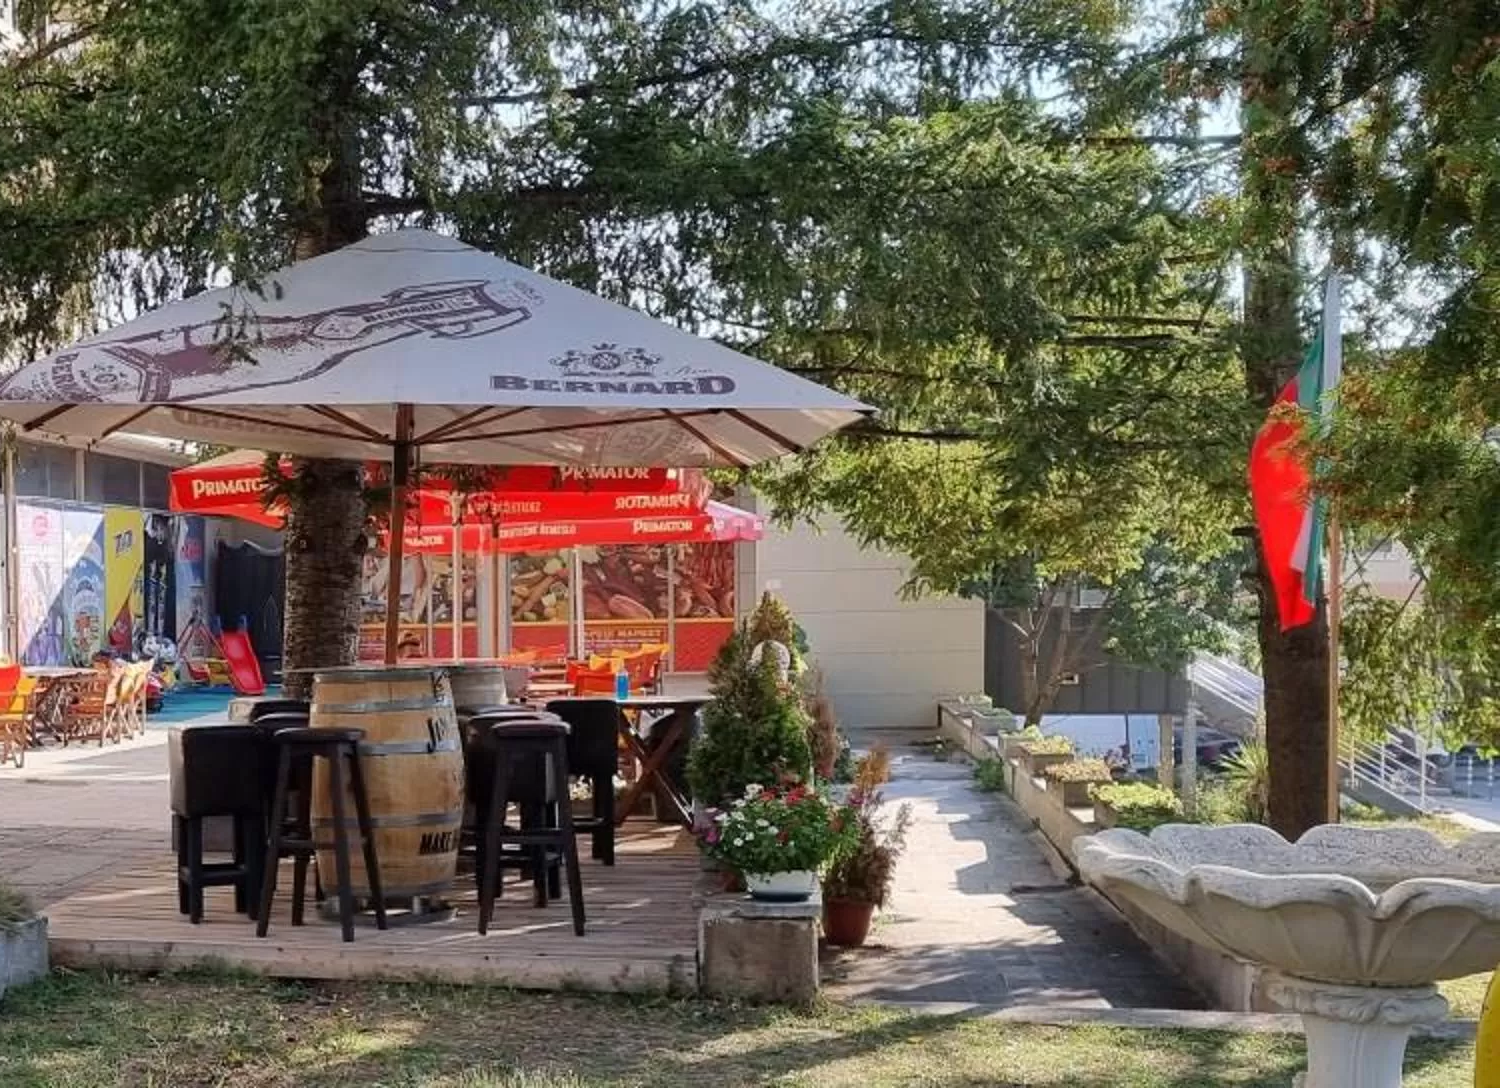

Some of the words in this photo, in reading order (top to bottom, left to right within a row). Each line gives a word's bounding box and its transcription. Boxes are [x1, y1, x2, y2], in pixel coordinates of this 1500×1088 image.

[490, 375, 736, 395] BERNARD
[192, 478, 265, 500] PRIMATO
[633, 519, 693, 534] PRIMATOR
